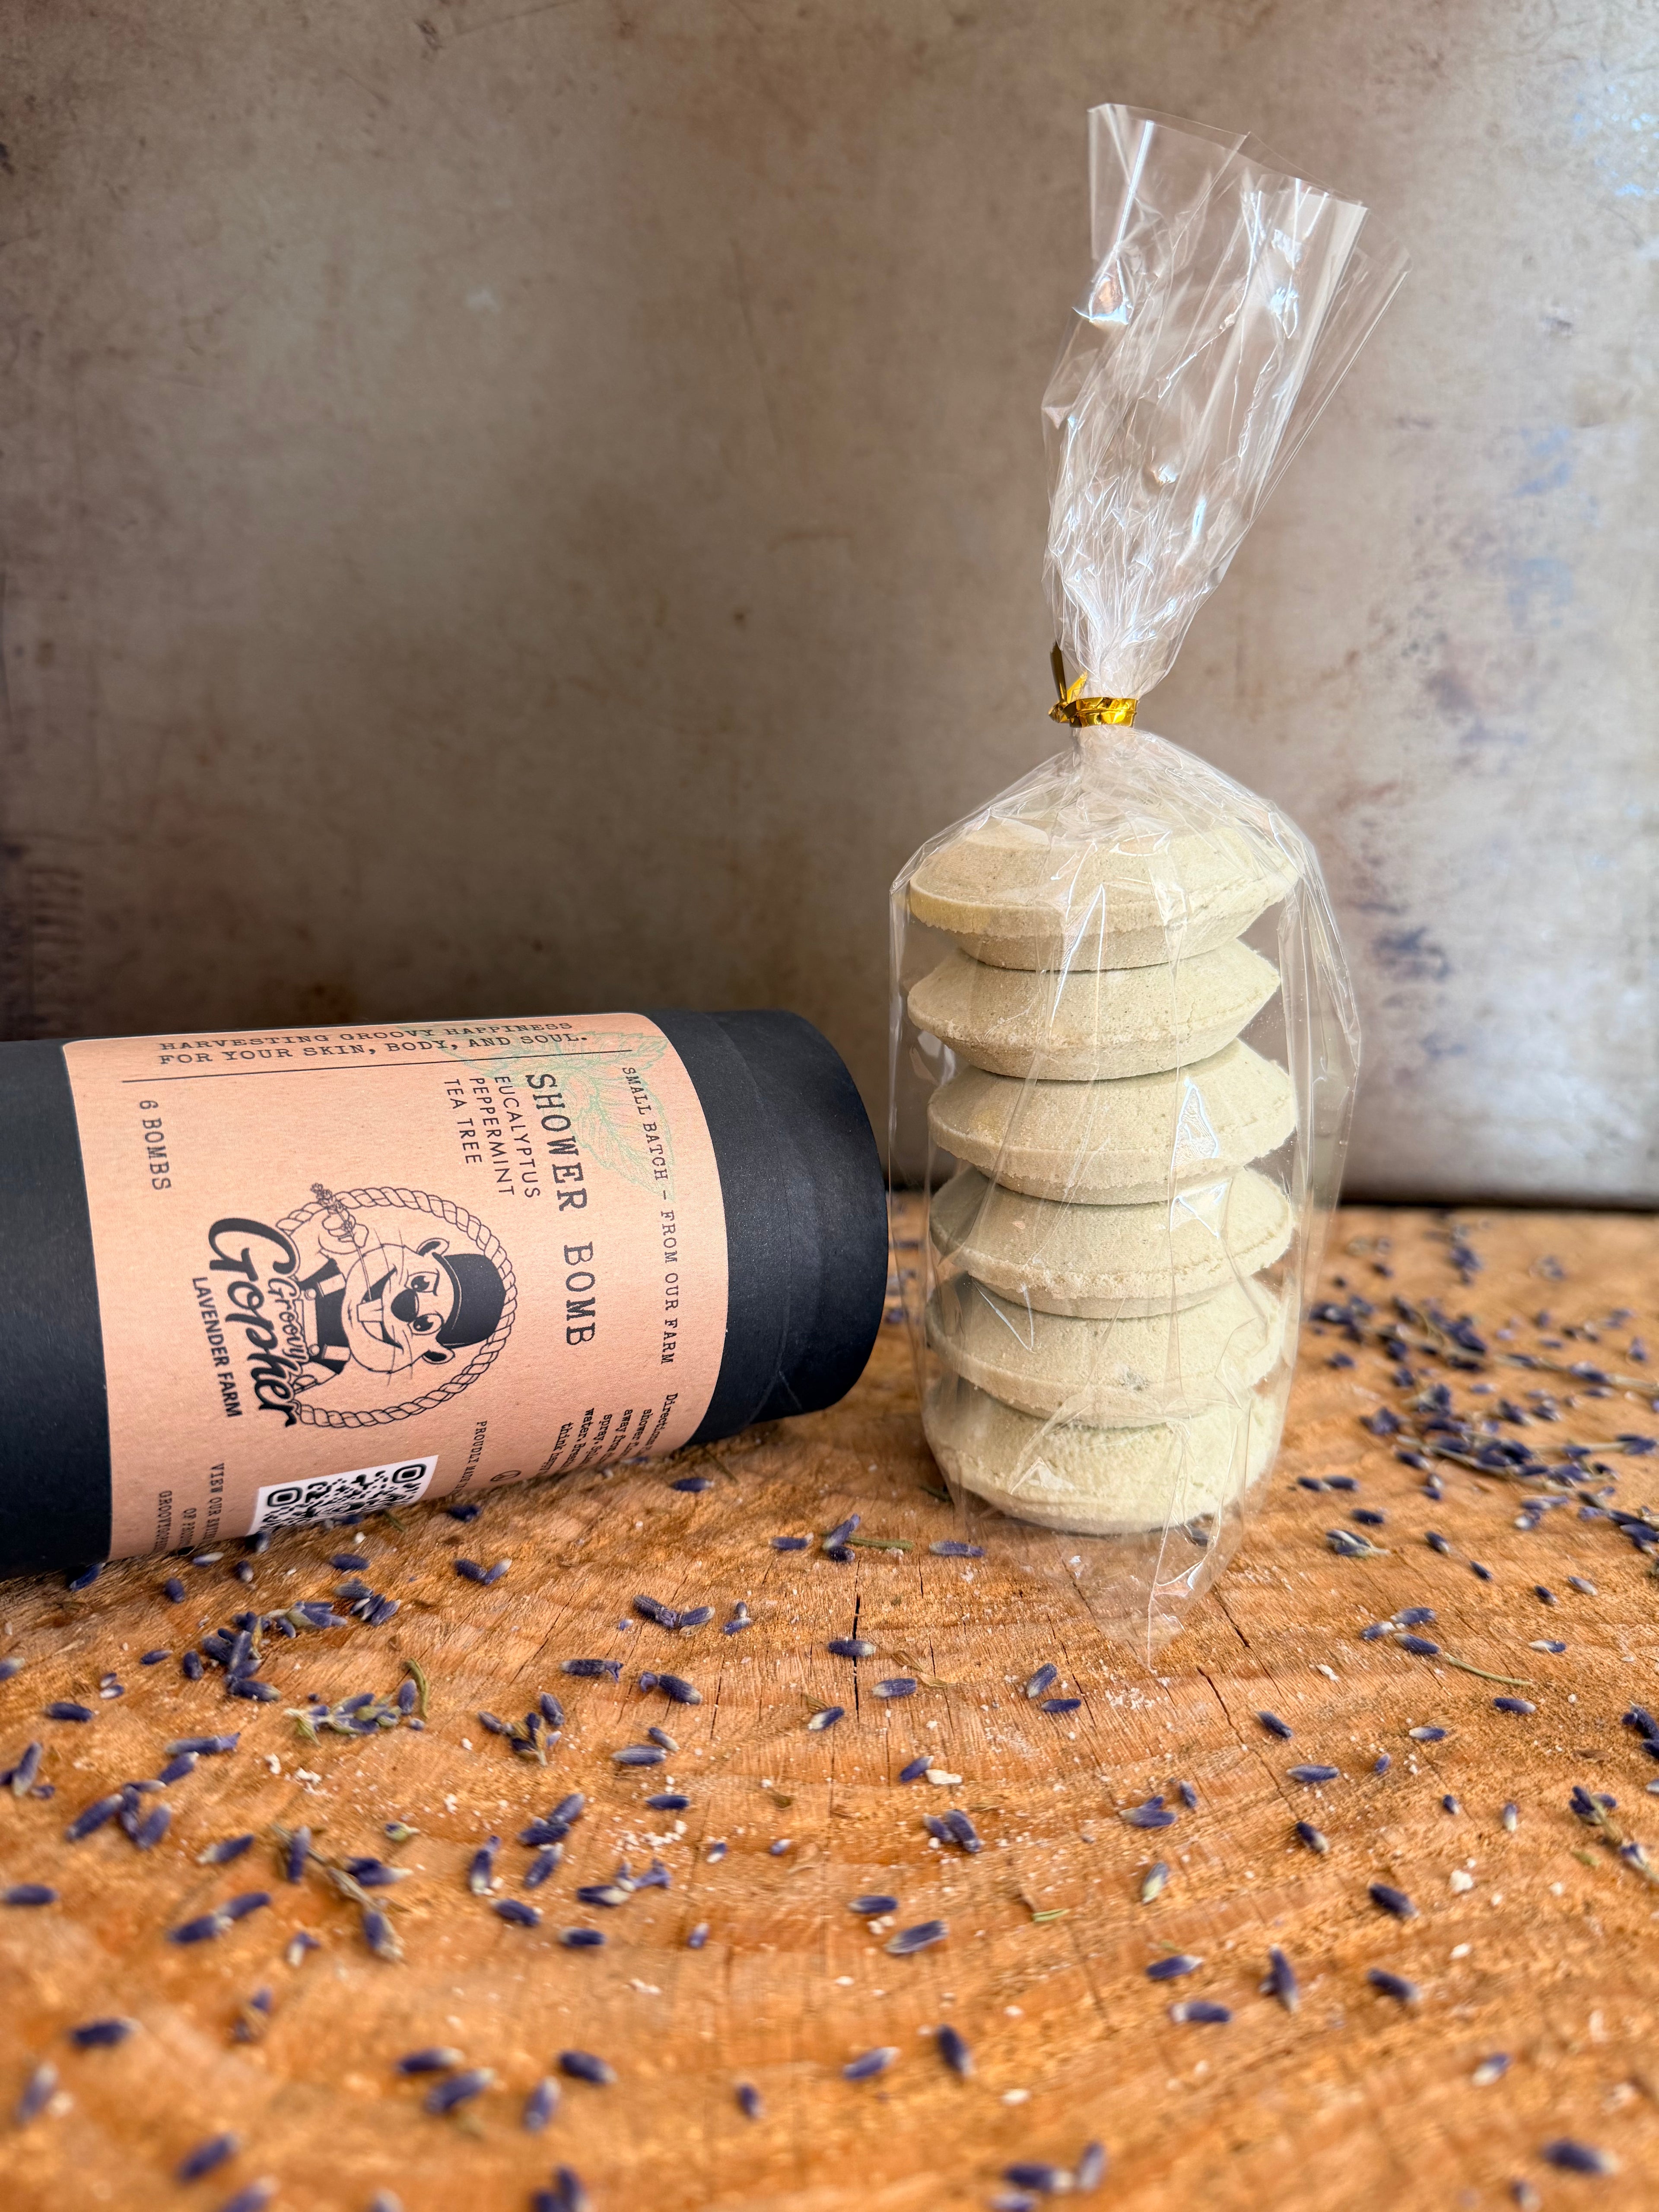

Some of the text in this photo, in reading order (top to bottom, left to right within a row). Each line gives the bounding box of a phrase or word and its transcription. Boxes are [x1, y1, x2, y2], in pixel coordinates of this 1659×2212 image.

[159, 1033, 587, 1065] FOR YOUR SKIN, BODY, AND SOUL.
[160, 1023, 573, 1050] HARVESTING GROOVY HAPPINESS
[622, 1067, 652, 1115] SMALL
[444, 1079, 483, 1163] TEA TREE
[469, 1078, 514, 1195] PEPPERMINT
[494, 1076, 540, 1198] EUCALYPTUS
[140, 1100, 172, 1190] 6 BOMBS
[643, 1122, 668, 1180] BATCH
[525, 1074, 595, 1345] SHOWER BOMB
[661, 1210, 677, 1263] FROM
[665, 1273, 679, 1310] OUR
[208, 1218, 302, 1427] Gopher
[268, 1278, 308, 1363] Groovy
[661, 1318, 677, 1364] FARM
[192, 1277, 242, 1418] LAVENDER FARM
[468, 1421, 487, 1464] PROUDLY
[553, 1422, 574, 1451] think
[576, 1408, 594, 1442] water.
[616, 1409, 633, 1432] away
[632, 1409, 653, 1440] shower
[211, 1463, 225, 1493] VIEW
[459, 1465, 477, 1482] MADE
[184, 1508, 197, 1519] OF
[208, 1497, 222, 1516] OUR
